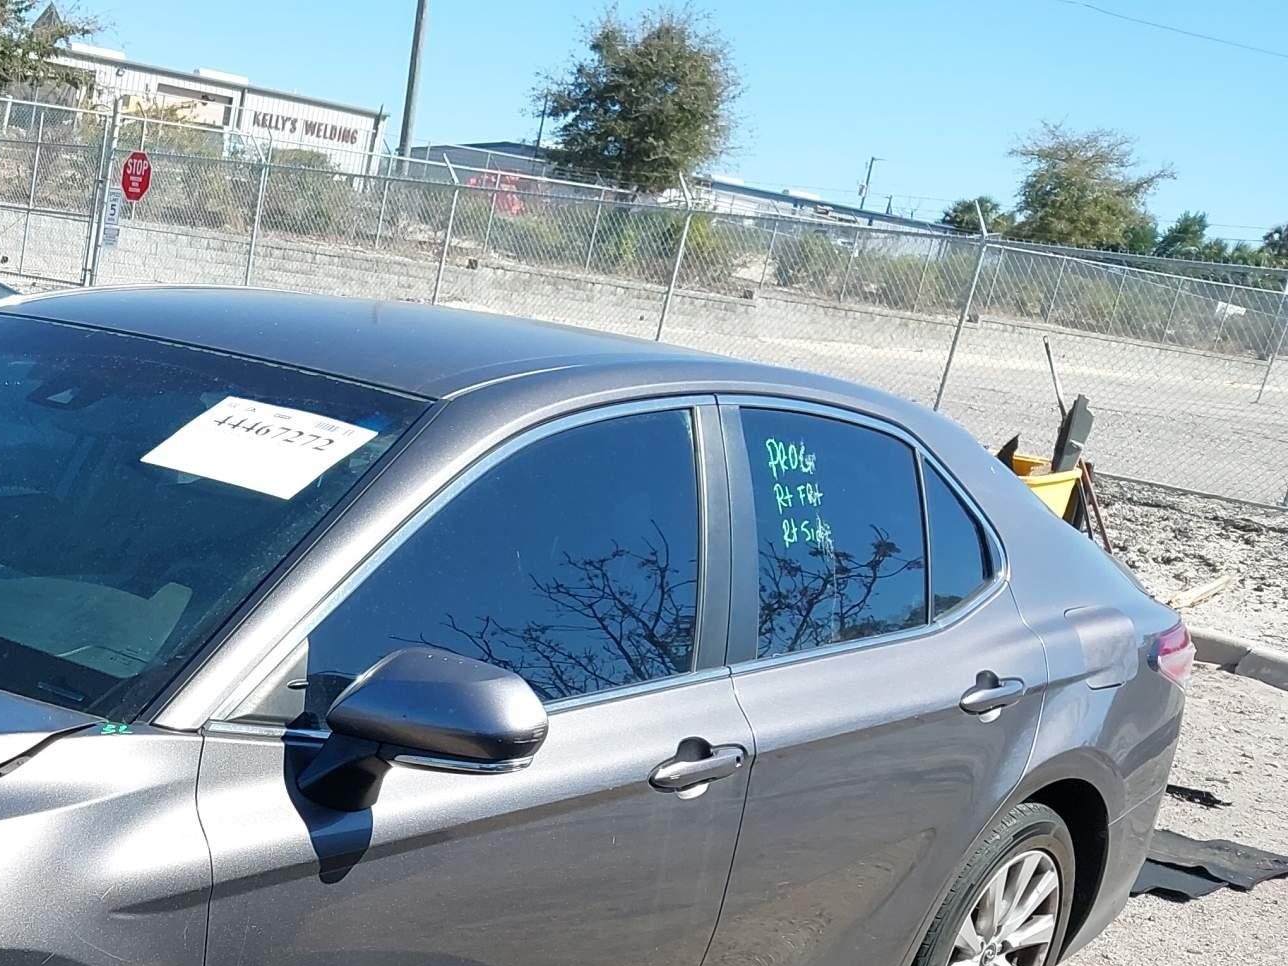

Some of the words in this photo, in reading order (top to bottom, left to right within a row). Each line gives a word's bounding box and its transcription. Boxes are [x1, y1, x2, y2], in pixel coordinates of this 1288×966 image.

[252, 111, 298, 134] KELLY'S
[304, 120, 359, 145] WELDING
[127, 159, 149, 175] STOP
[109, 204, 116, 217] 5
[214, 415, 335, 451] 44467272
